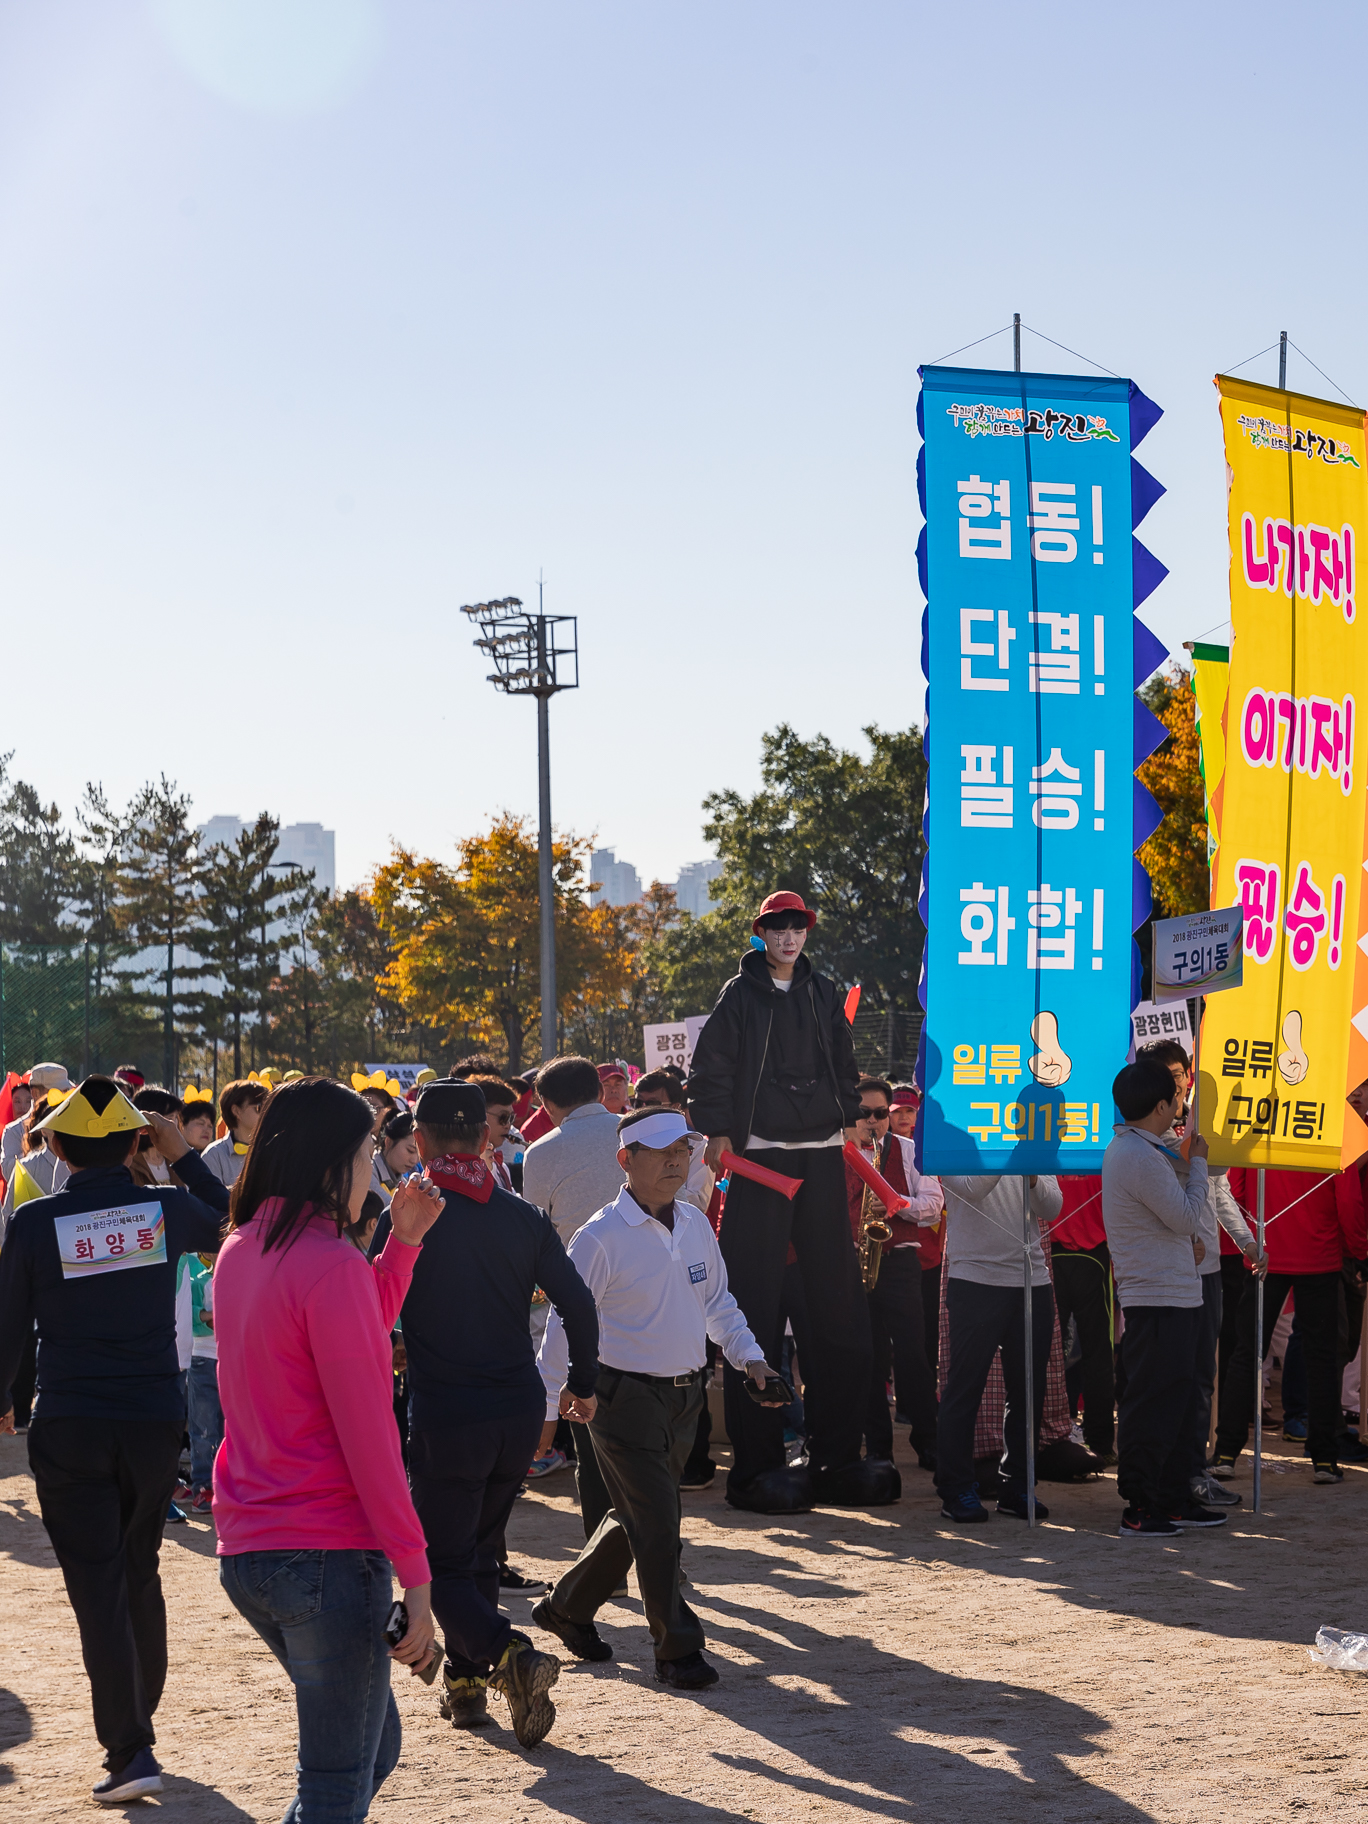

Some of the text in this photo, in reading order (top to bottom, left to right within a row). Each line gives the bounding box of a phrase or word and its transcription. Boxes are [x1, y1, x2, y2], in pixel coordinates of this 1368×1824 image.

[1024, 409, 1091, 442] 광진
[1292, 429, 1340, 464] 광진
[957, 474, 1104, 565] 협동!
[1243, 516, 1354, 621] 나가자!
[960, 607, 1105, 696] 단결!
[1243, 692, 1354, 793] 이기자!
[960, 744, 1105, 832] 필승!
[957, 881, 1104, 972] 화합!
[1237, 863, 1344, 967] 필승!
[1172, 931, 1187, 944] 2018
[1172, 941, 1229, 981] 구의1동
[1133, 1010, 1188, 1038] 광장현대
[952, 1043, 1022, 1086] 일류
[1221, 1037, 1275, 1080] 일류
[967, 1101, 1100, 1144] 구의1동!
[1227, 1095, 1326, 1141] 구의1동!
[74, 1227, 155, 1260] 화양동
[75, 1223, 92, 1233] 2018
